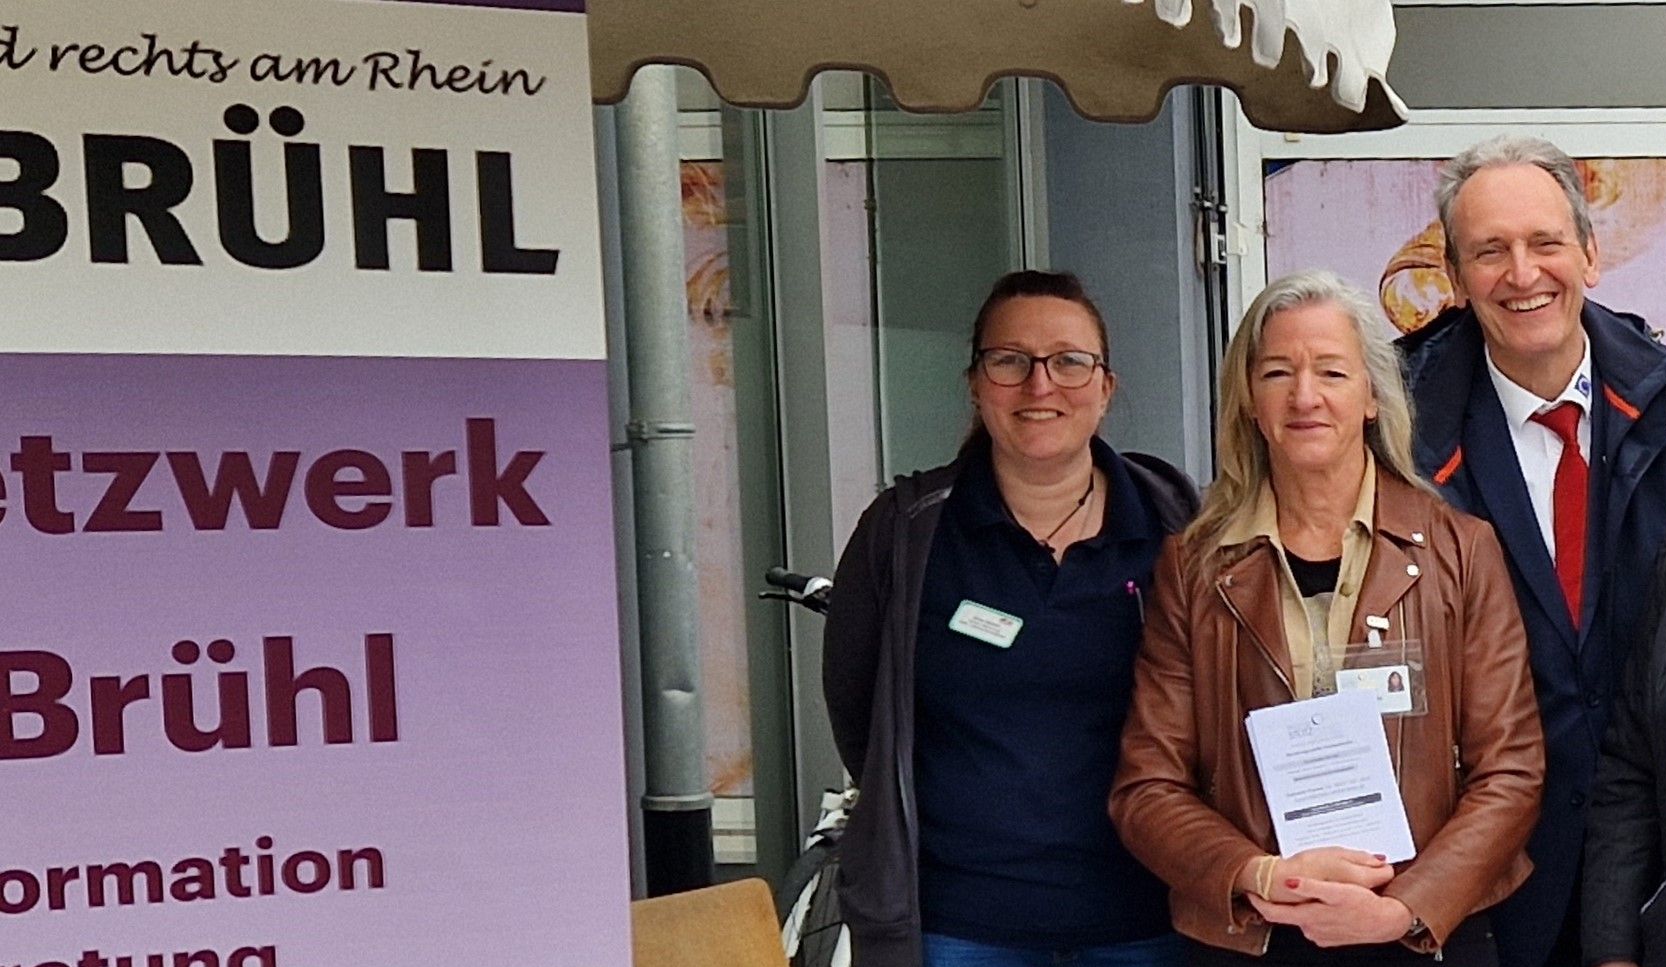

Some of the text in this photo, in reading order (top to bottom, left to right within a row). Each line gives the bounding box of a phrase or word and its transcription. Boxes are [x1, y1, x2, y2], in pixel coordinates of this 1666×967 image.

[49, 33, 240, 84] rechts
[250, 51, 356, 87] am
[362, 49, 547, 97] Rhein
[0, 103, 561, 275] BRÜHL
[0, 418, 552, 536] tzwerk
[0, 633, 399, 760] Brühl
[0, 836, 387, 915] ormation
